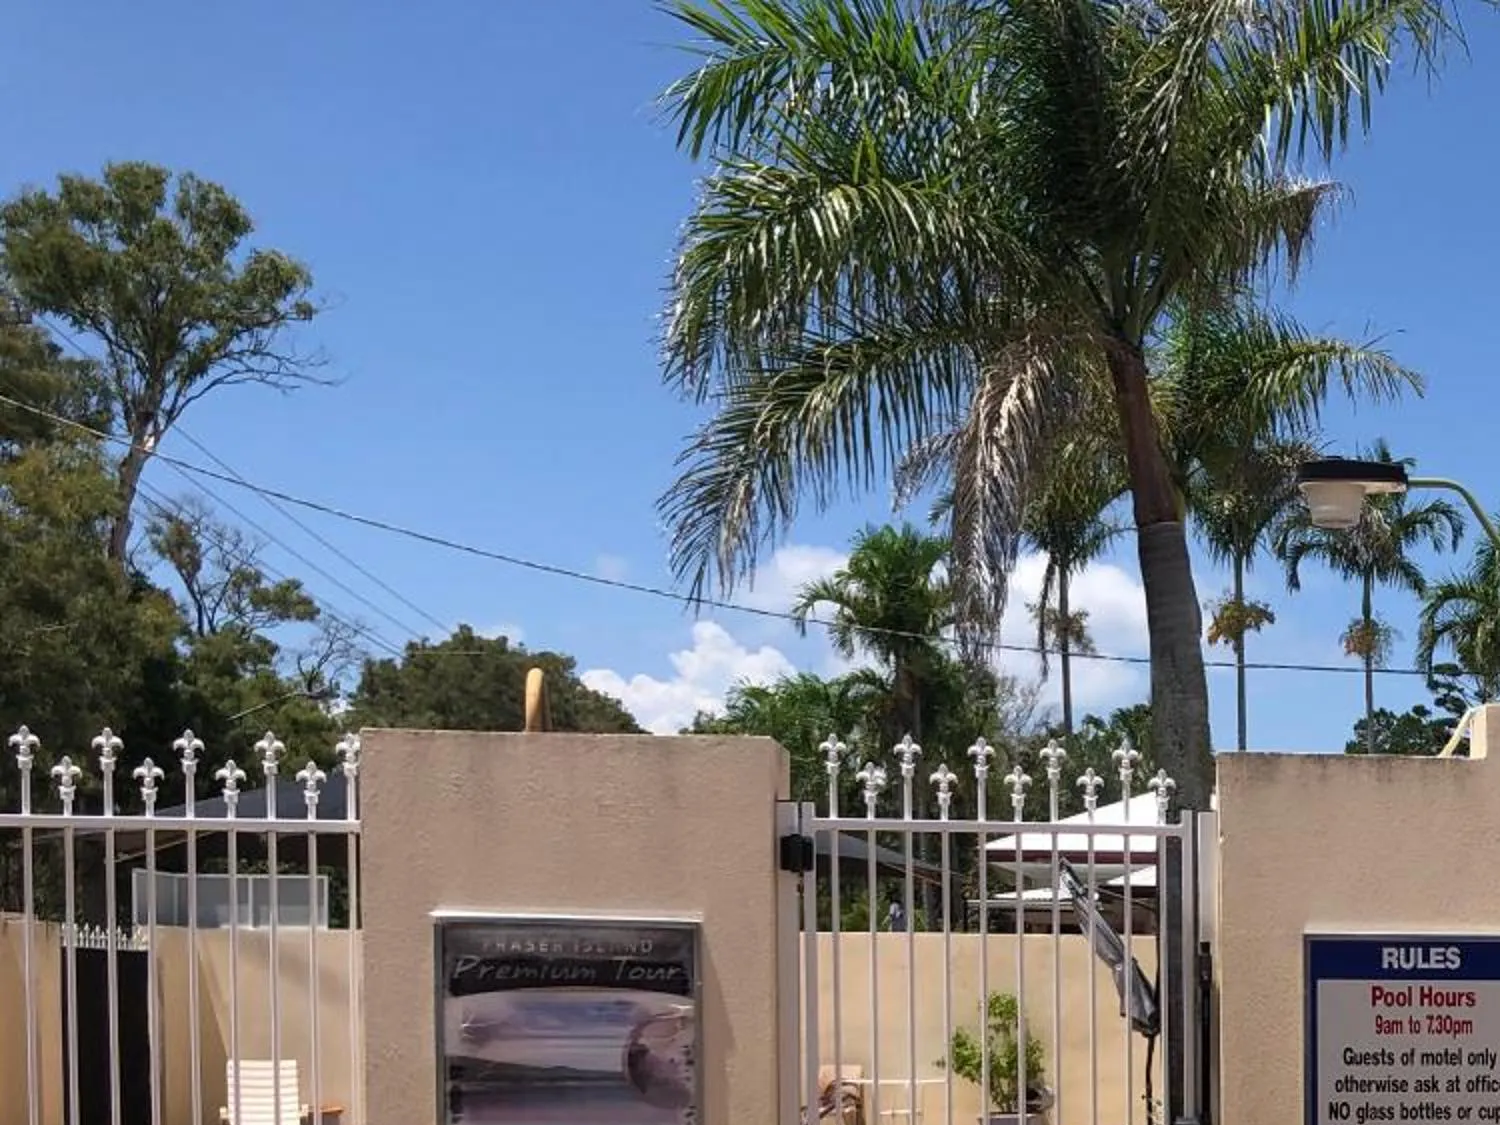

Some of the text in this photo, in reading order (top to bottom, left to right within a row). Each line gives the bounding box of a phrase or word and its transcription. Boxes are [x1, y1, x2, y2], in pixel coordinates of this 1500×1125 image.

[453, 955, 682, 980] Premium Tour
[1382, 947, 1461, 969] RULES
[1371, 986, 1476, 1007] Pool Hours
[1375, 1015, 1403, 1035] 9am
[1408, 1015, 1421, 1035] to
[1343, 1047, 1497, 1069] Guests of motel only
[1335, 1075, 1409, 1093] otherwise
[1414, 1076, 1440, 1093] ask
[1446, 1076, 1461, 1093] at
[1328, 1102, 1350, 1120] NO
[1356, 1102, 1395, 1124] glass
[1400, 1102, 1451, 1120] bottles
[1457, 1105, 1472, 1120] or
